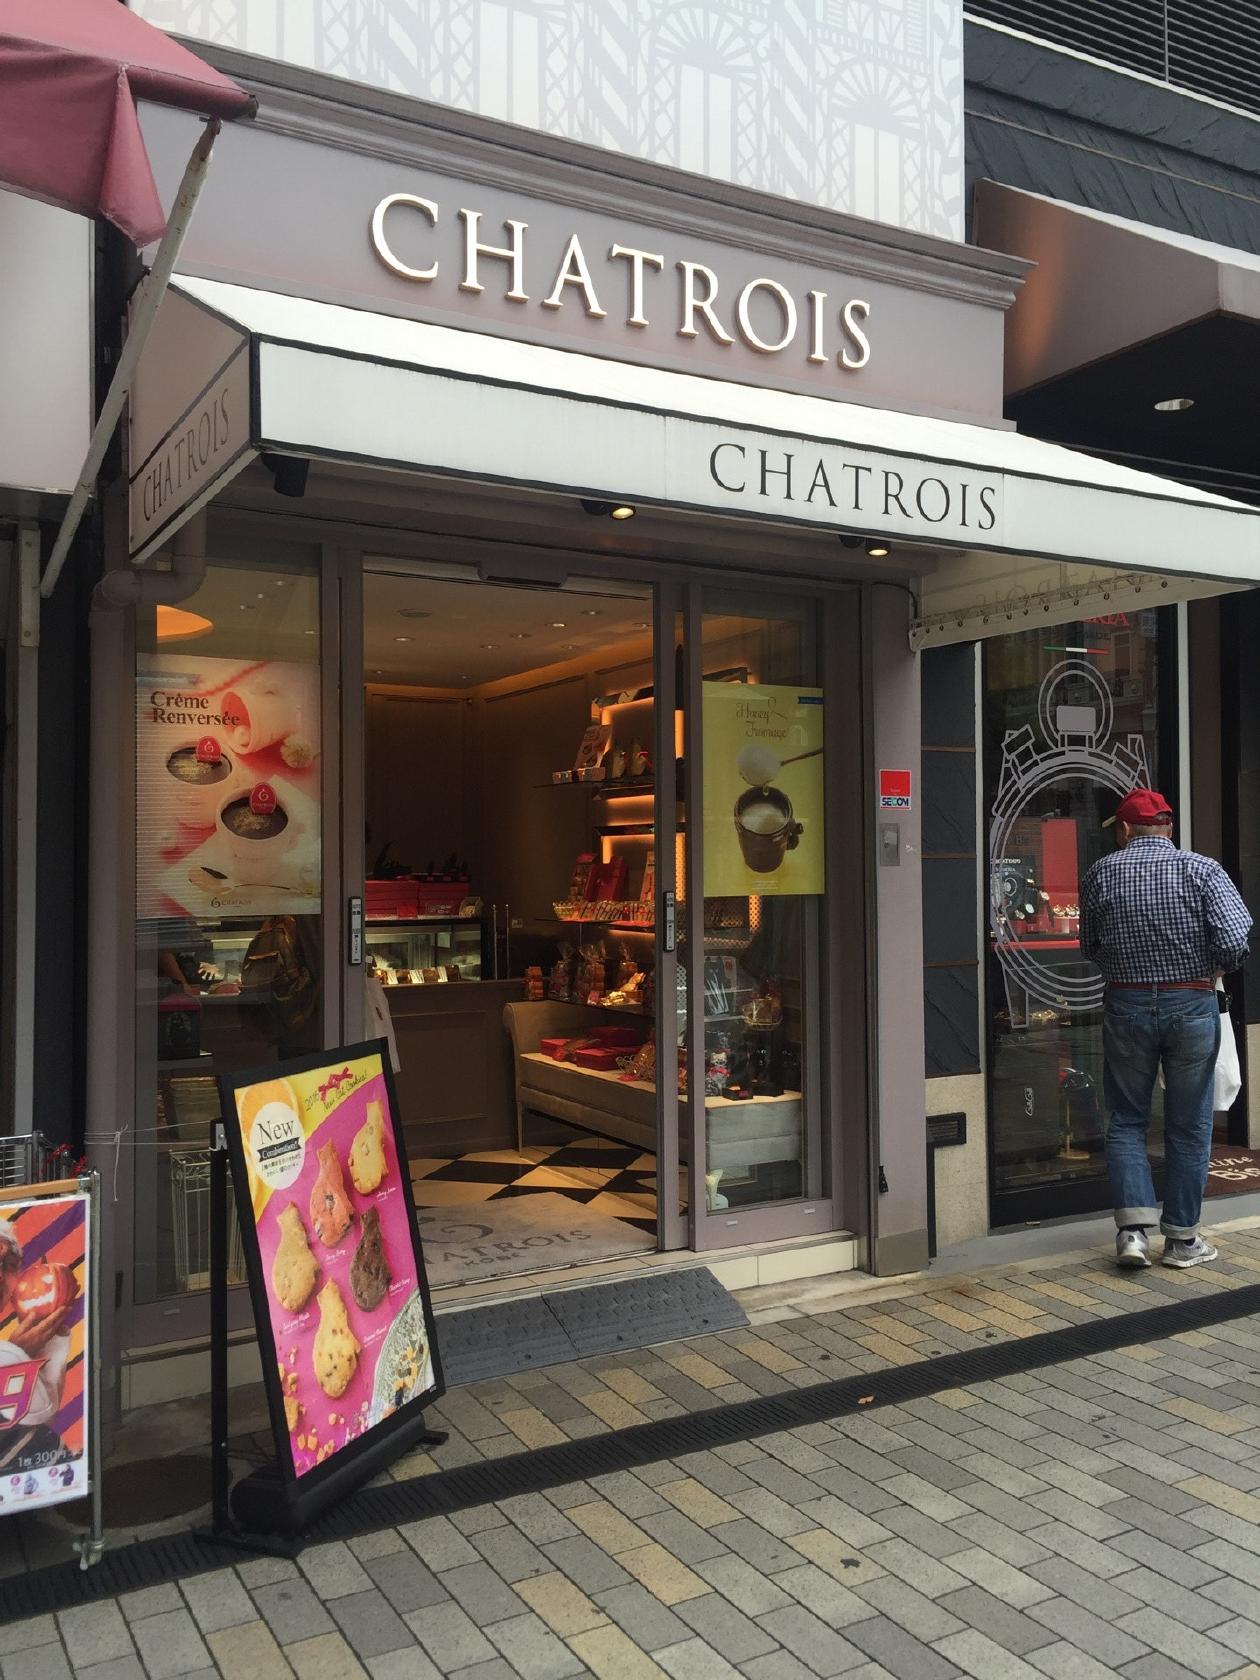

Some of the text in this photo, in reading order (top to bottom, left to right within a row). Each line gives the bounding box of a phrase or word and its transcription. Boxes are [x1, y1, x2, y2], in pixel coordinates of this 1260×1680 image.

[369, 192, 873, 372] CHATROIS
[143, 388, 229, 522] CHATROIS
[709, 442, 998, 531] CHATROIS
[151, 708, 241, 726] Renversée
[881, 797, 909, 807] SECOM
[257, 1119, 294, 1145] New
[424, 1229, 593, 1267] ATROIS
[463, 1252, 523, 1267] KOBE
